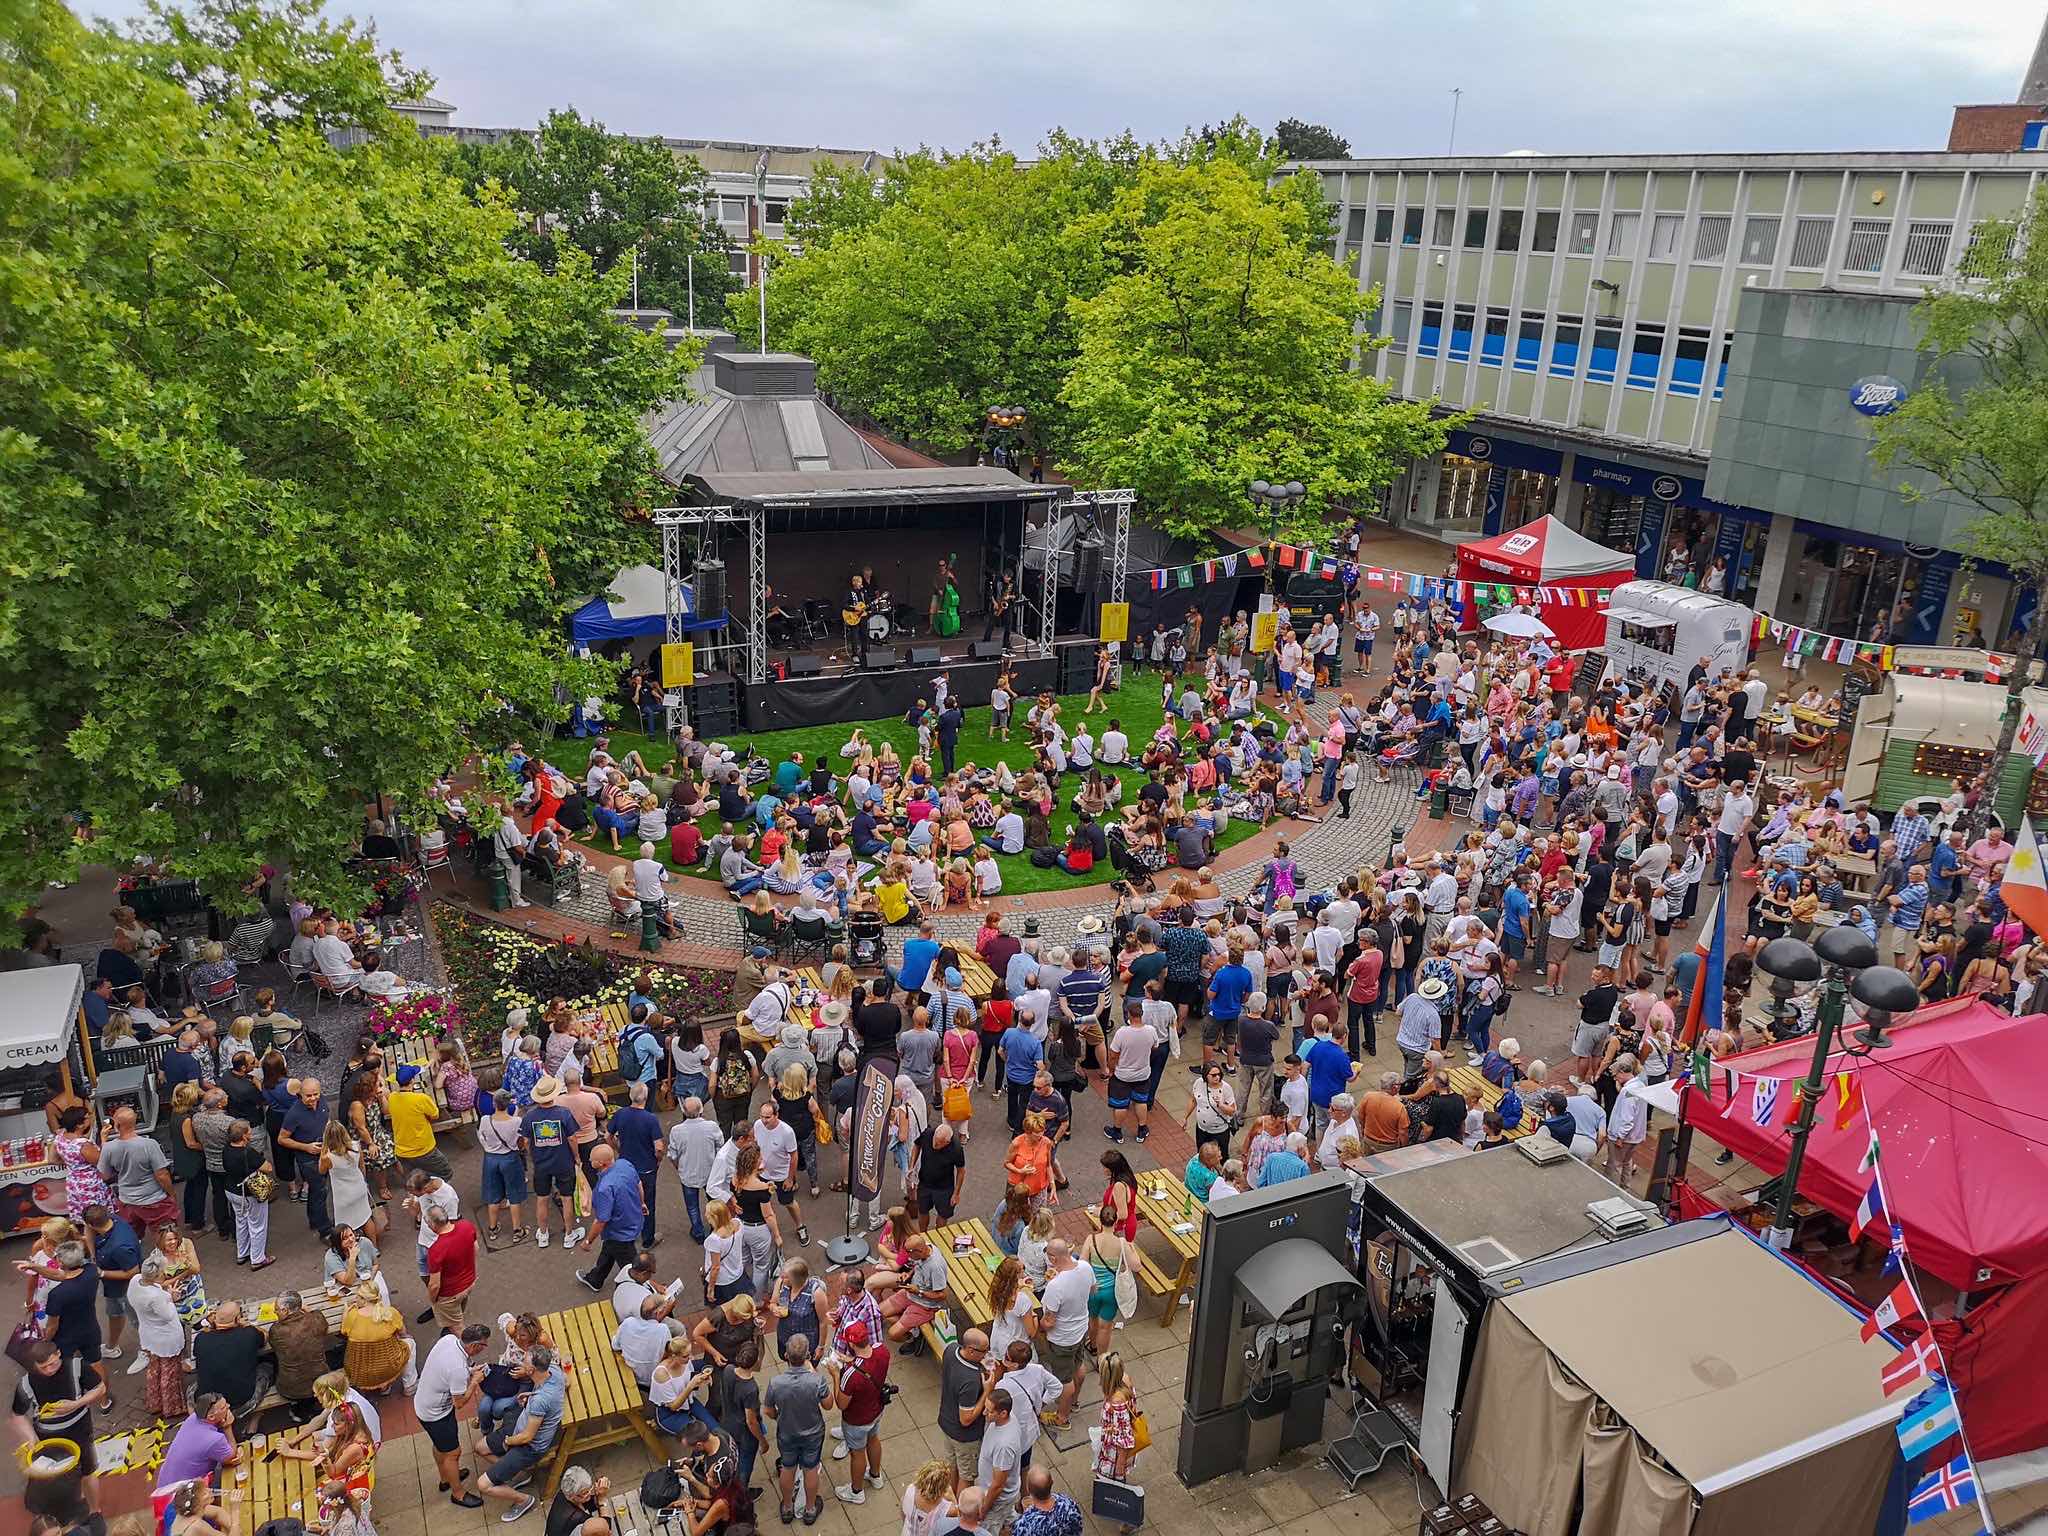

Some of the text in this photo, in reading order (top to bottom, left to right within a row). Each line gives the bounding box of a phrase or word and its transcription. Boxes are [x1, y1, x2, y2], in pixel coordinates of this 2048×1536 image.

[1592, 468, 1632, 485] pharmacy
[6, 1044, 58, 1059] CREAM
[871, 1075, 886, 1118] Cider
[1270, 1217, 1285, 1228] BT
